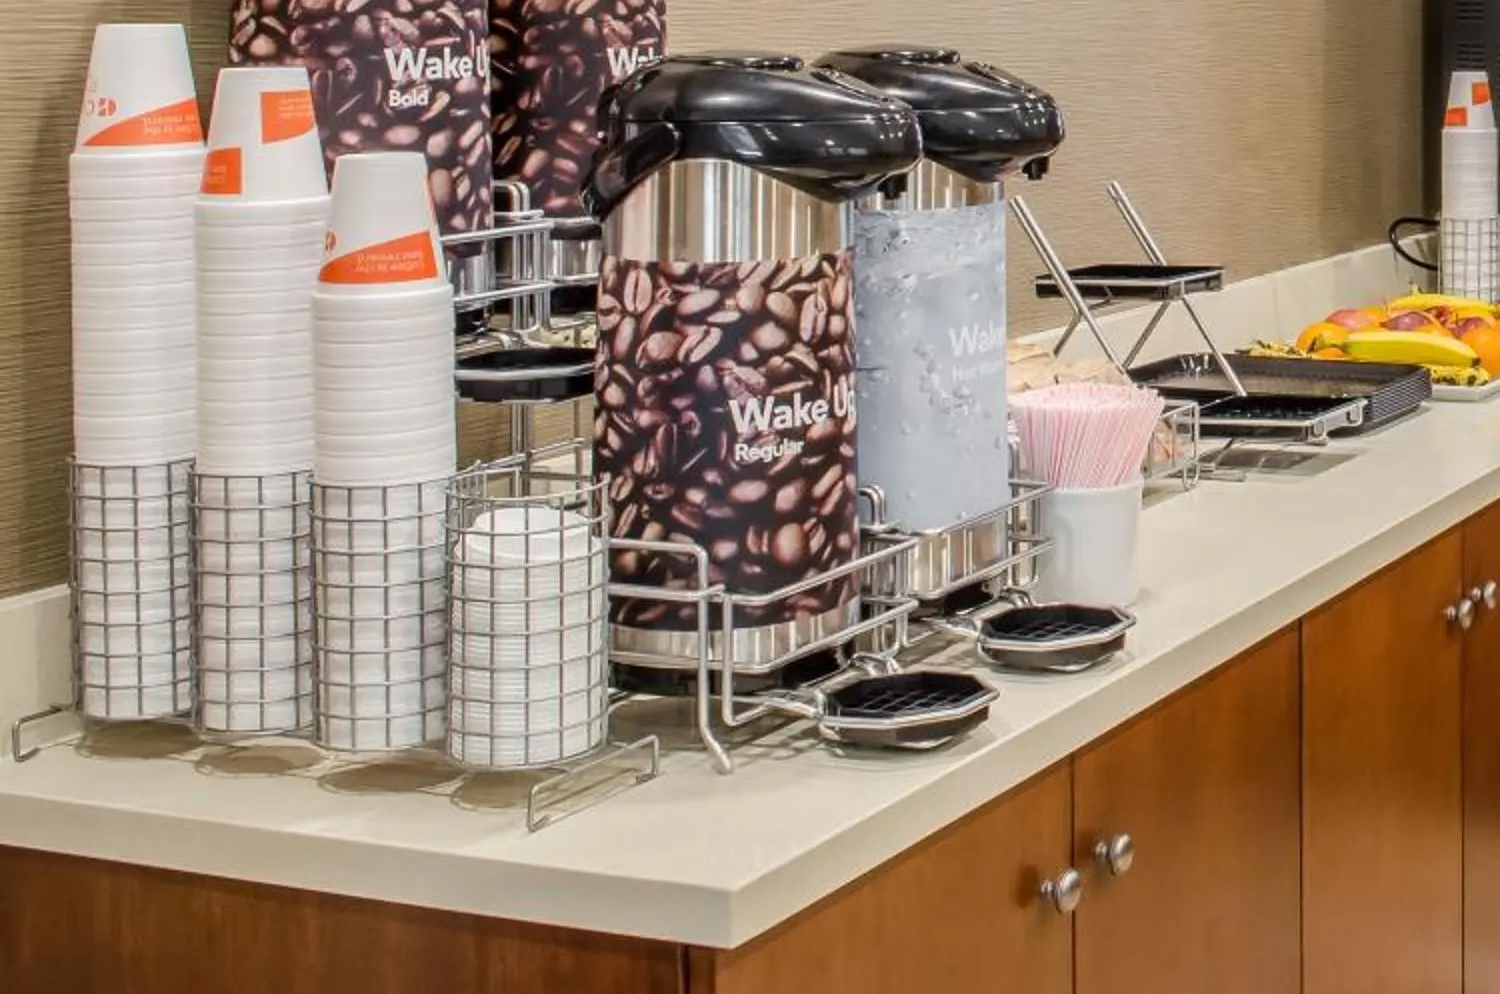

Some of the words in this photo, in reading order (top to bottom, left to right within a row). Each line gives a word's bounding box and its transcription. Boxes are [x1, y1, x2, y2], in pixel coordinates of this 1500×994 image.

[384, 47, 473, 81] Wake
[389, 88, 429, 107] Bold
[728, 392, 829, 433] Wake
[735, 438, 804, 463] Regular
